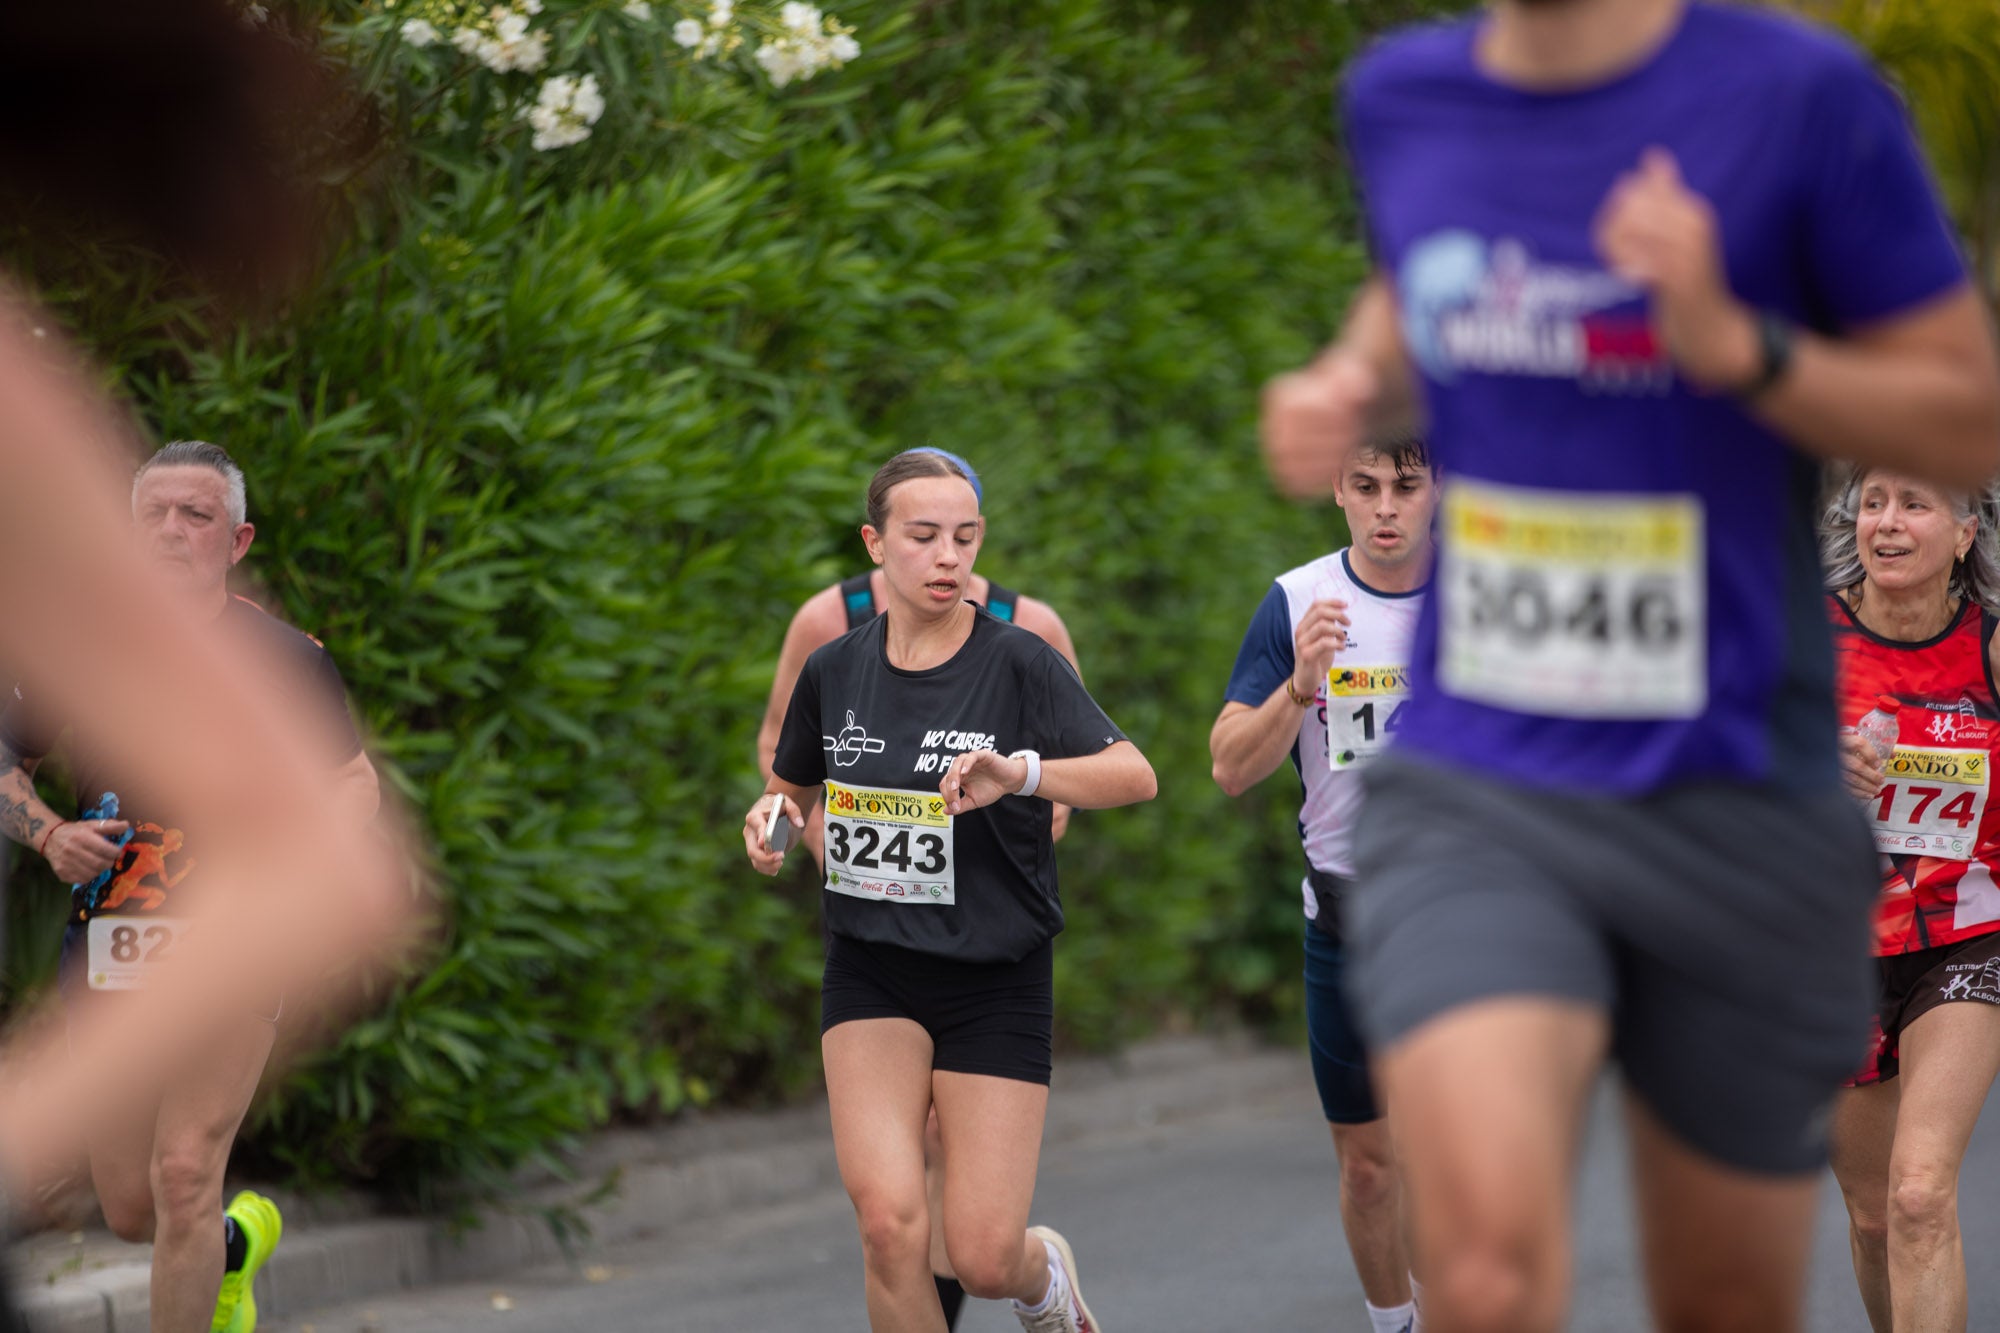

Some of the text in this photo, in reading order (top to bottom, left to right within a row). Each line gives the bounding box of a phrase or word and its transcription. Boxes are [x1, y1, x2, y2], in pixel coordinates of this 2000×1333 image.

[1466, 566, 1683, 649] 3046
[1926, 702, 1960, 711] ATLETISMO
[921, 730, 945, 748] NO
[914, 753, 956, 774] NO F
[1917, 753, 1952, 763] PREMIO
[1889, 759, 1958, 777] ONDO
[836, 790, 855, 810] 38
[857, 792, 882, 801] GRAN
[884, 794, 916, 803] PREMIO
[1874, 783, 1976, 829] 174
[855, 799, 922, 818] FONDO
[828, 821, 947, 875] 3243
[1945, 964, 1983, 972] ATLETISM
